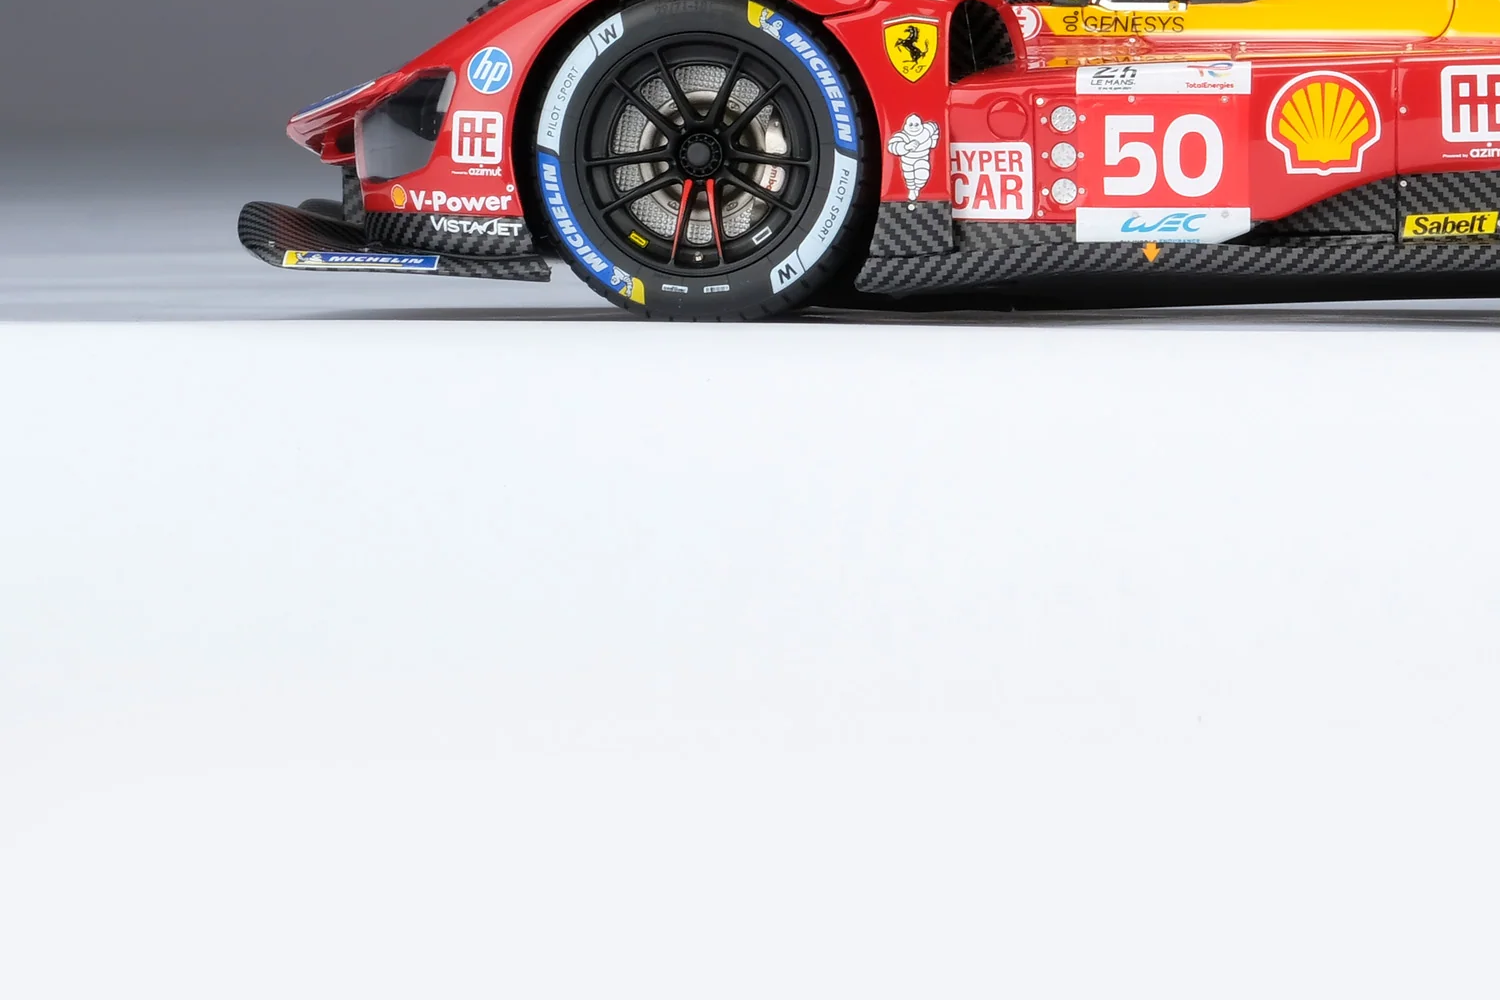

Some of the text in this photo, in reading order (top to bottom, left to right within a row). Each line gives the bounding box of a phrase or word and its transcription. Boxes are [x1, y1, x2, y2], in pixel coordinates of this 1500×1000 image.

[598, 23, 617, 45] W
[1084, 15, 1185, 33] GENESYS
[473, 50, 508, 92] hp
[785, 32, 853, 142] MICHELIN
[1185, 82, 1234, 90] TotalEnergies
[547, 66, 579, 138] PILOT SPORT
[950, 150, 1023, 172] HYPER
[1103, 113, 1224, 197] 50
[468, 164, 502, 177] azimut
[409, 190, 512, 212] V-Power
[951, 174, 1023, 210] CAR
[819, 168, 850, 242] PILOT SPORT
[542, 163, 609, 273] MICHELIN
[1120, 212, 1207, 232] WEC
[1412, 214, 1485, 235] Sabelt
[329, 255, 424, 265] MICHELIN
[777, 263, 798, 284] W
